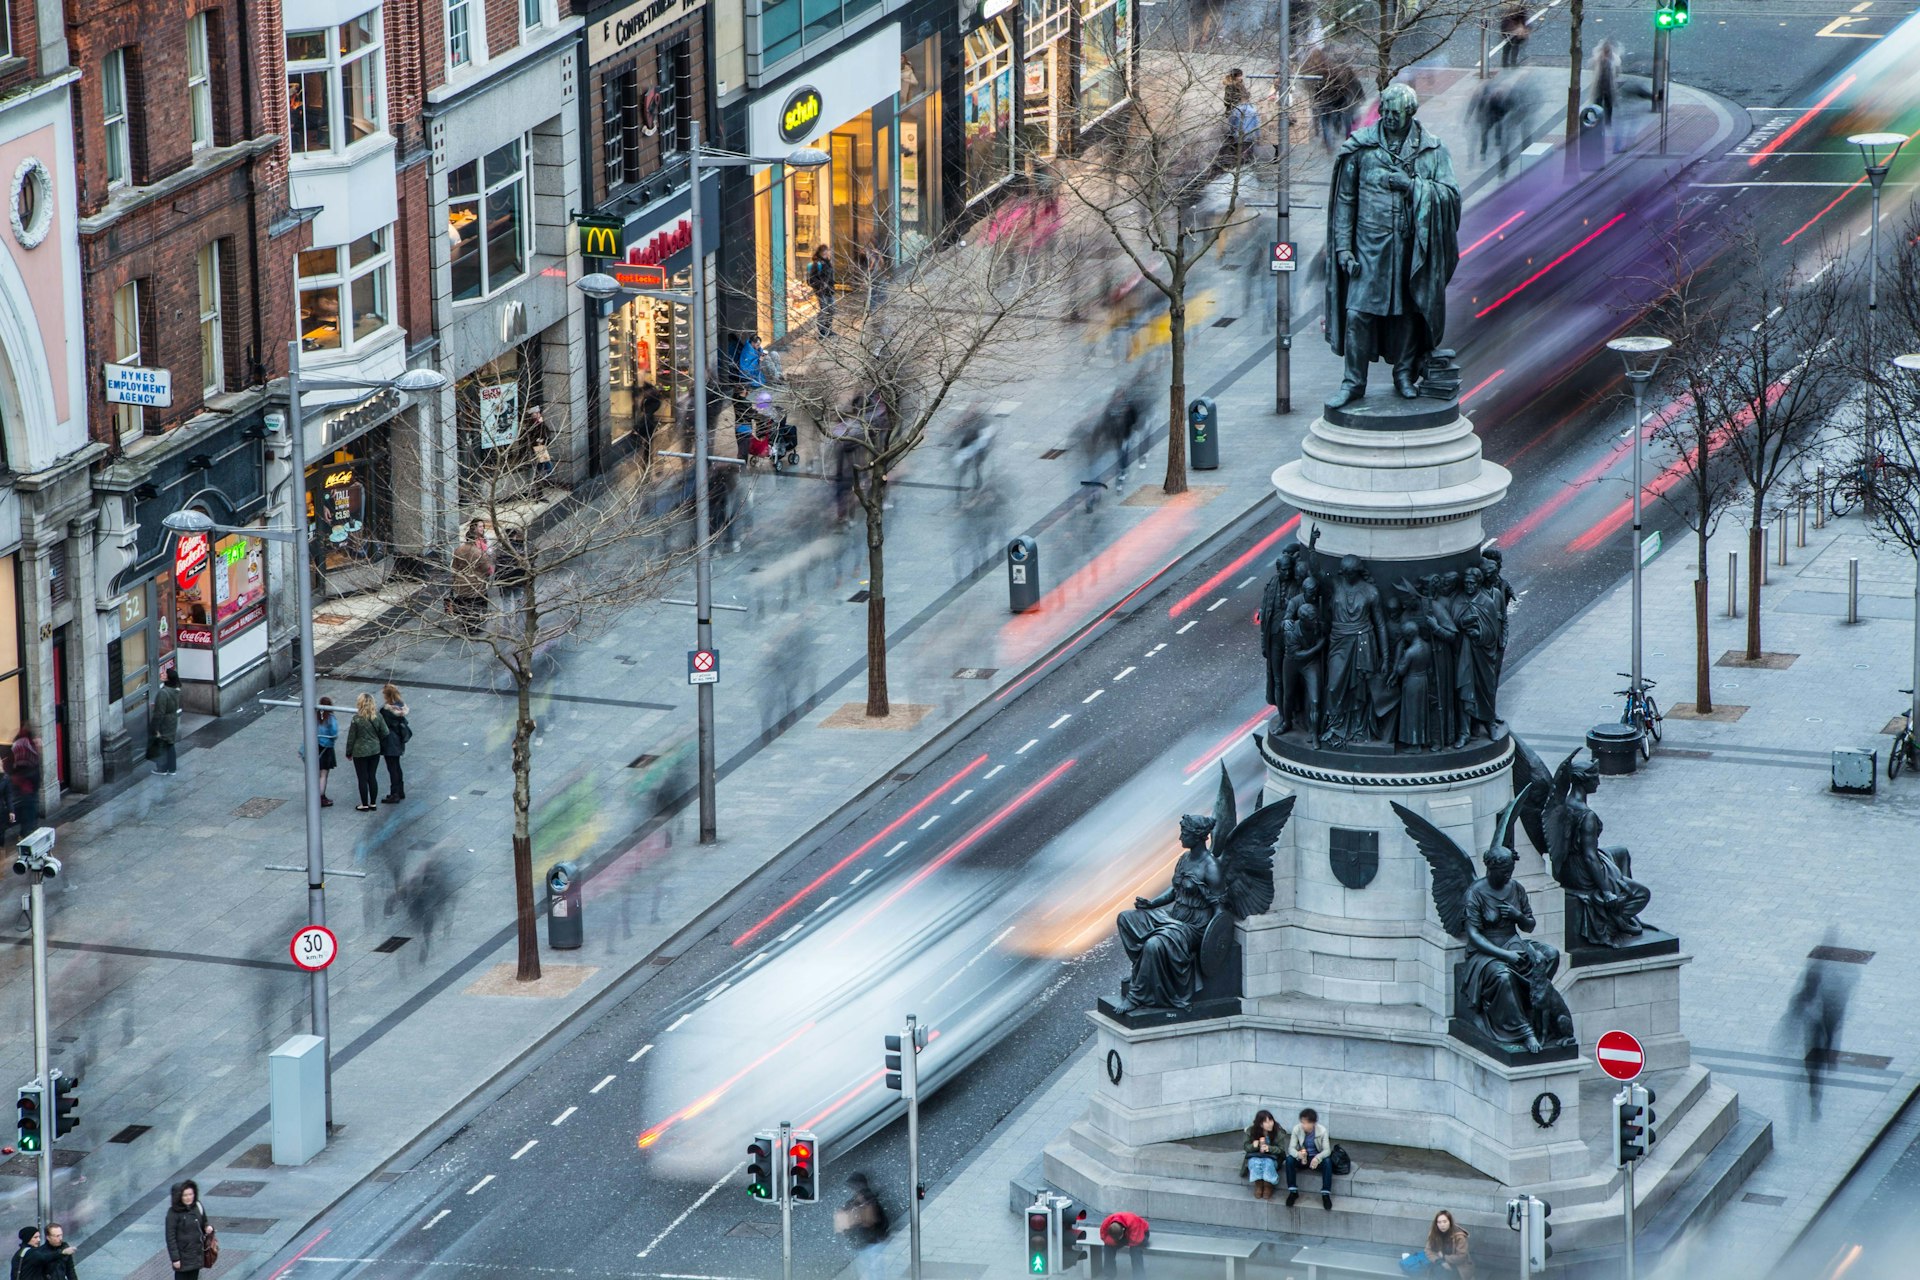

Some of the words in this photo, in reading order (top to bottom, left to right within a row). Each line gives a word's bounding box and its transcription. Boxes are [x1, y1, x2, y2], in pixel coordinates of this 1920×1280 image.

[785, 95, 818, 130] schuh
[121, 370, 155, 383] HYNES
[108, 379, 166, 394] EMPLOYMENT
[119, 391, 155, 404] AGENCY
[335, 489, 349, 500] TALL
[125, 596, 140, 621] 52
[304, 934, 322, 952] 30
